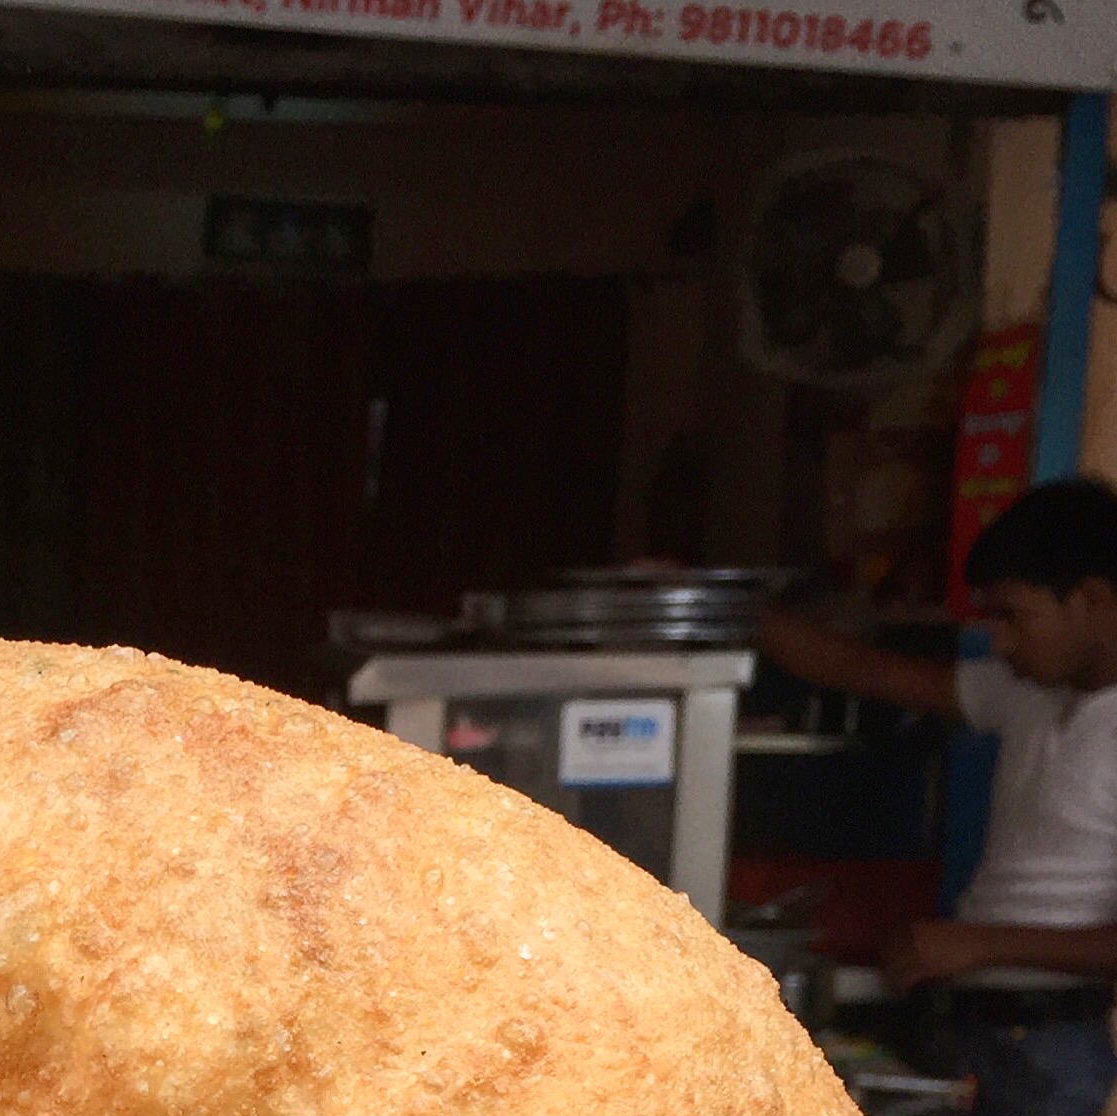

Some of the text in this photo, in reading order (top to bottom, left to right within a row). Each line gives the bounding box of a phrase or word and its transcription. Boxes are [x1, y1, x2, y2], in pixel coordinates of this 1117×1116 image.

[282, 0, 933, 60] man Vihar, Ph: 9811018466
